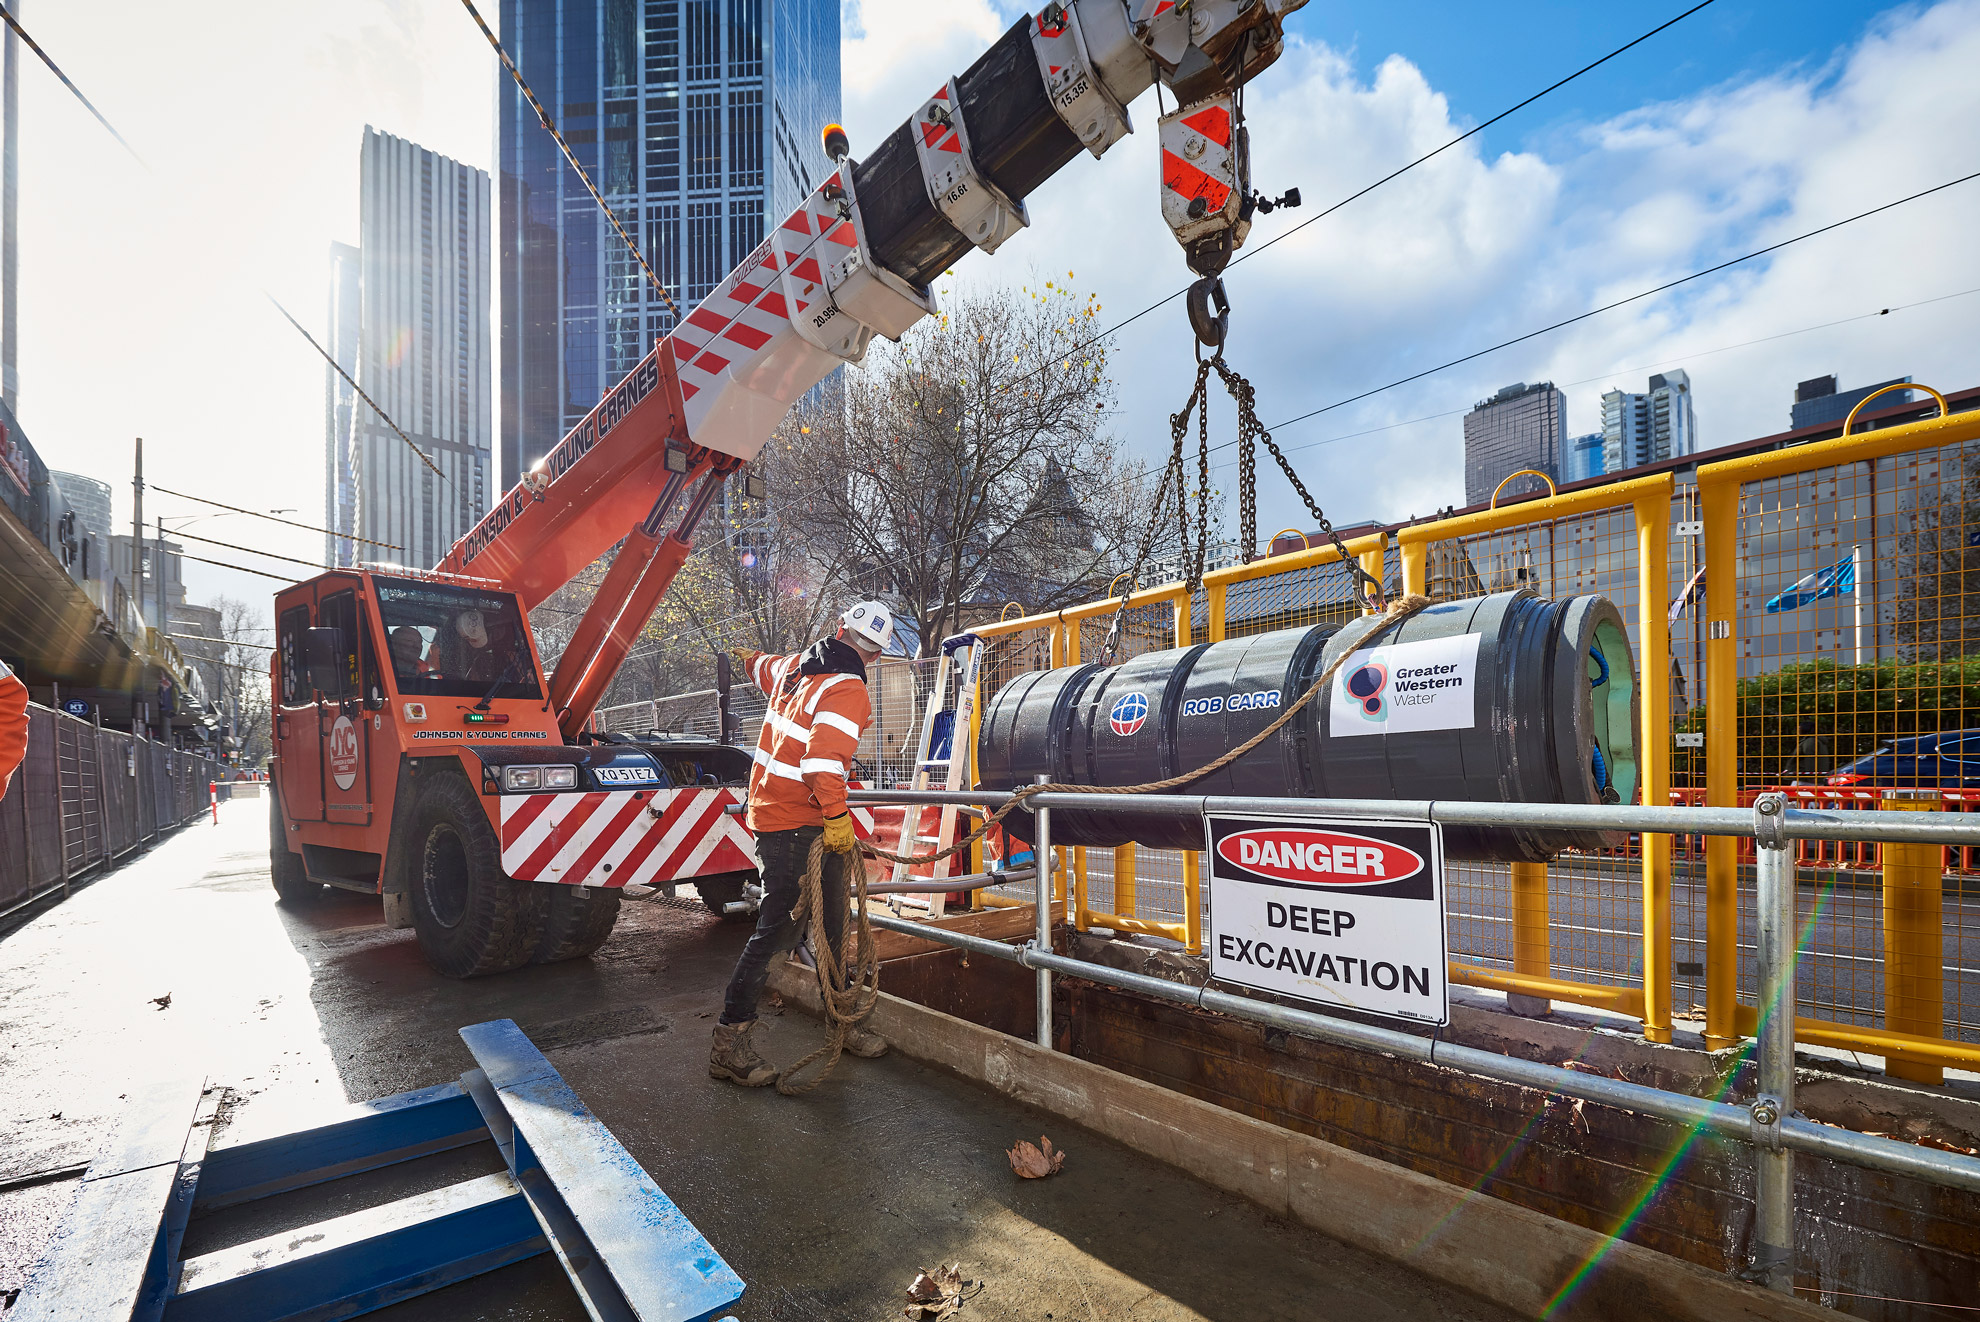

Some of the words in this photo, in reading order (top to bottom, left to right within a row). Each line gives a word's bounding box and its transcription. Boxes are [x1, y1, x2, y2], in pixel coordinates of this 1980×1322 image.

[1060, 80, 1089, 108] 15.35t
[946, 183, 969, 204] 16.6t
[462, 499, 512, 567] JOHNSON
[514, 489, 525, 515] &
[547, 417, 595, 482] YOUNG
[597, 355, 659, 439] CRANES
[1395, 676, 1463, 692] Western
[1396, 662, 1458, 680] Greater
[1183, 696, 1222, 717] ROB
[1226, 689, 1281, 711] CARR
[1394, 692, 1437, 707] Water
[331, 726, 356, 757] JYC
[413, 730, 463, 739] JOHNSON
[510, 731, 547, 739] CRANES
[1239, 838, 1386, 877] DANGER
[1266, 901, 1356, 938] DEEP
[1219, 933, 1430, 997] EXCAVATION
